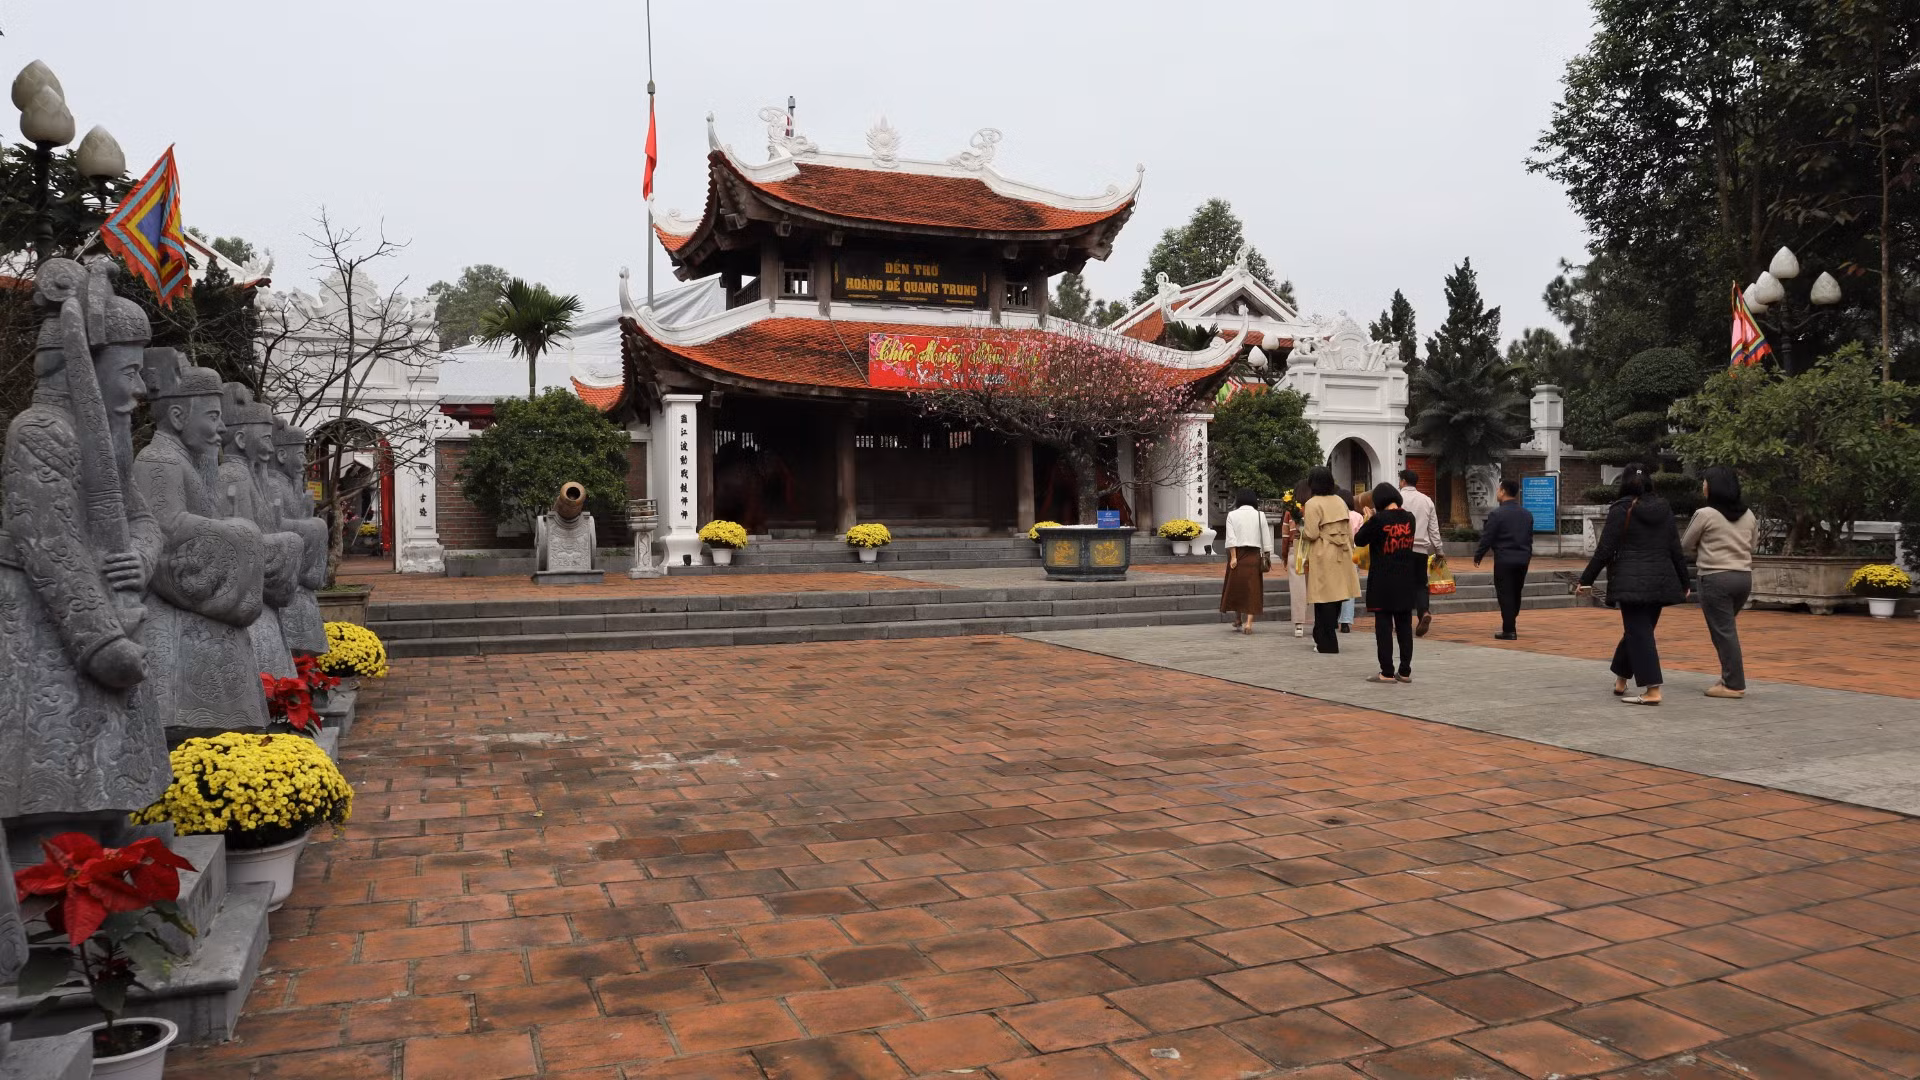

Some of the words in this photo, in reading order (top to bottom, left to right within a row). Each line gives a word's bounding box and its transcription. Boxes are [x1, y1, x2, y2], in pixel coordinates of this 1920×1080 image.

[845, 275, 883, 291] HOÀNG
[903, 281, 939, 294] QUANG
[942, 283, 978, 297] TRUNG
[876, 338, 916, 365] Chúc
